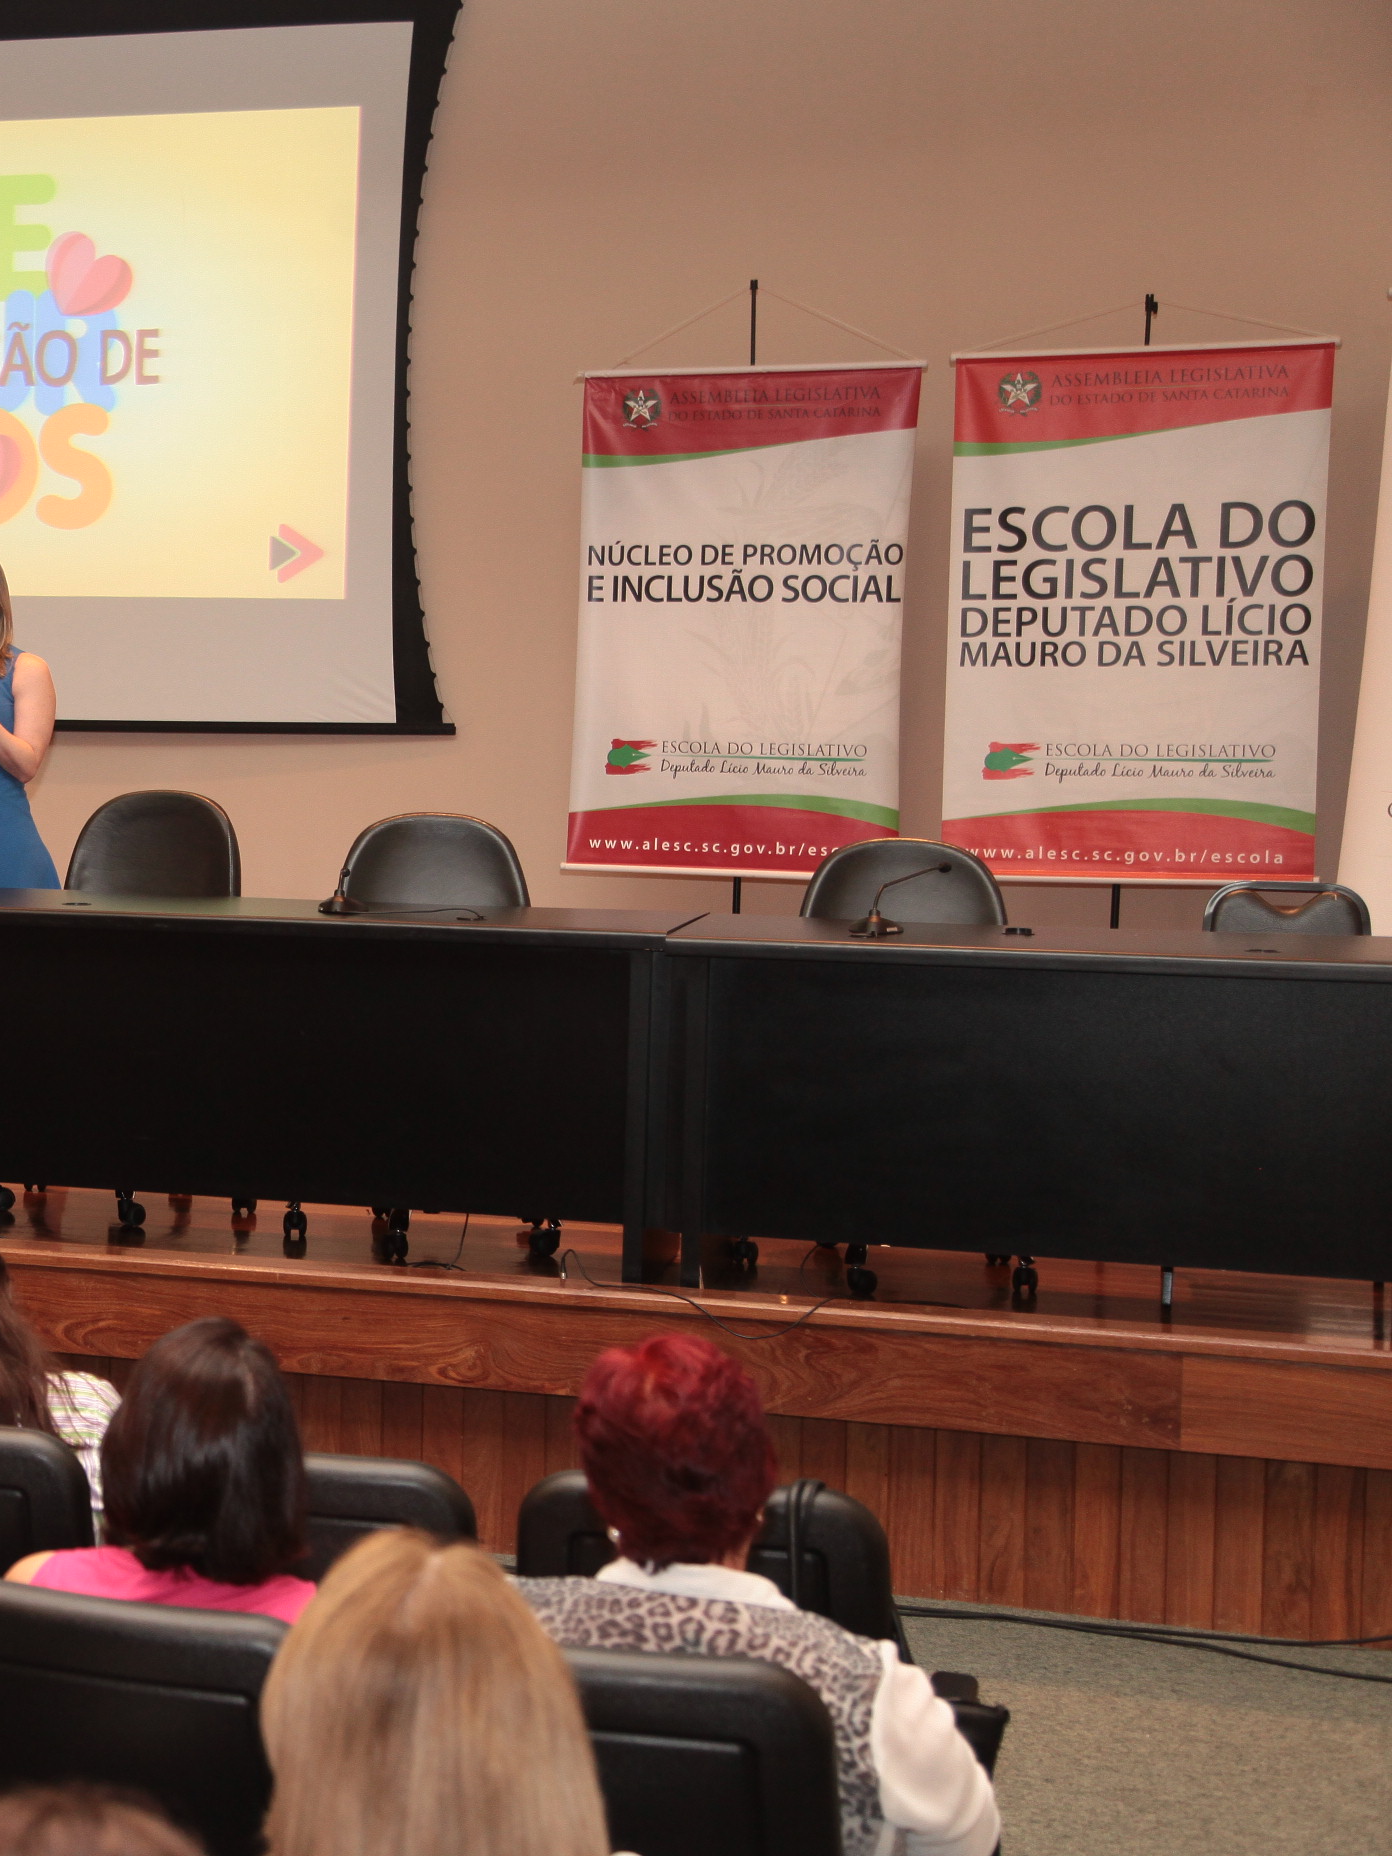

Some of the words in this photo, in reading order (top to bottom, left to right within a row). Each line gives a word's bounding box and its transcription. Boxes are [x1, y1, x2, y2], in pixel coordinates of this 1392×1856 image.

[99, 328, 161, 386] DE
[1052, 370, 1161, 387] ASSEMBLEIA
[1170, 365, 1289, 383] LEGISLATIVA
[671, 388, 769, 405] ASSEMBLEIA
[776, 386, 881, 402] LEGISLATIVA
[1050, 394, 1071, 406] DO
[1077, 391, 1133, 405] ESTADO
[1137, 391, 1156, 403] DE
[1162, 388, 1207, 402] SANTA
[1213, 386, 1289, 400] CATARINA
[669, 411, 688, 422] DO
[692, 409, 742, 421] ESTADO
[747, 408, 763, 420] DE
[767, 407, 809, 420] SANTA
[814, 406, 881, 419] CATARINA
[963, 504, 1198, 553] ESCOLA
[1219, 500, 1316, 549] DO
[587, 540, 693, 566] NÚCLEO
[700, 544, 734, 566] DE
[742, 539, 903, 572] PROMOÇÃO
[587, 575, 605, 603] E
[612, 568, 774, 603] INCLUSÃO
[781, 574, 902, 603] SOCIAL
[961, 554, 1314, 601] LEGISLATIVO
[960, 604, 1187, 638] DEPUTADO
[1201, 597, 1312, 637] LÍCIO
[959, 640, 1087, 668] MAURO
[1097, 640, 1146, 667] DA
[1157, 639, 1310, 667] SILVEIRA
[662, 740, 721, 755] ESCOLA
[727, 742, 753, 755] DO
[760, 743, 868, 758] LEGISLATIVO
[1046, 743, 1112, 757] ESCOLA
[1120, 743, 1148, 758] DO
[1156, 744, 1276, 758] LEGISLATIVO
[660, 759, 715, 779] Deputado
[719, 760, 749, 774] Lício
[752, 761, 794, 775] Mauro
[798, 762, 814, 776] da
[817, 761, 868, 777] Silveira
[1044, 762, 1106, 783] Deputado
[1112, 762, 1144, 778] Lício
[1148, 764, 1194, 778] Mauro
[1199, 764, 1217, 778] da
[1221, 763, 1276, 779] Silveira
